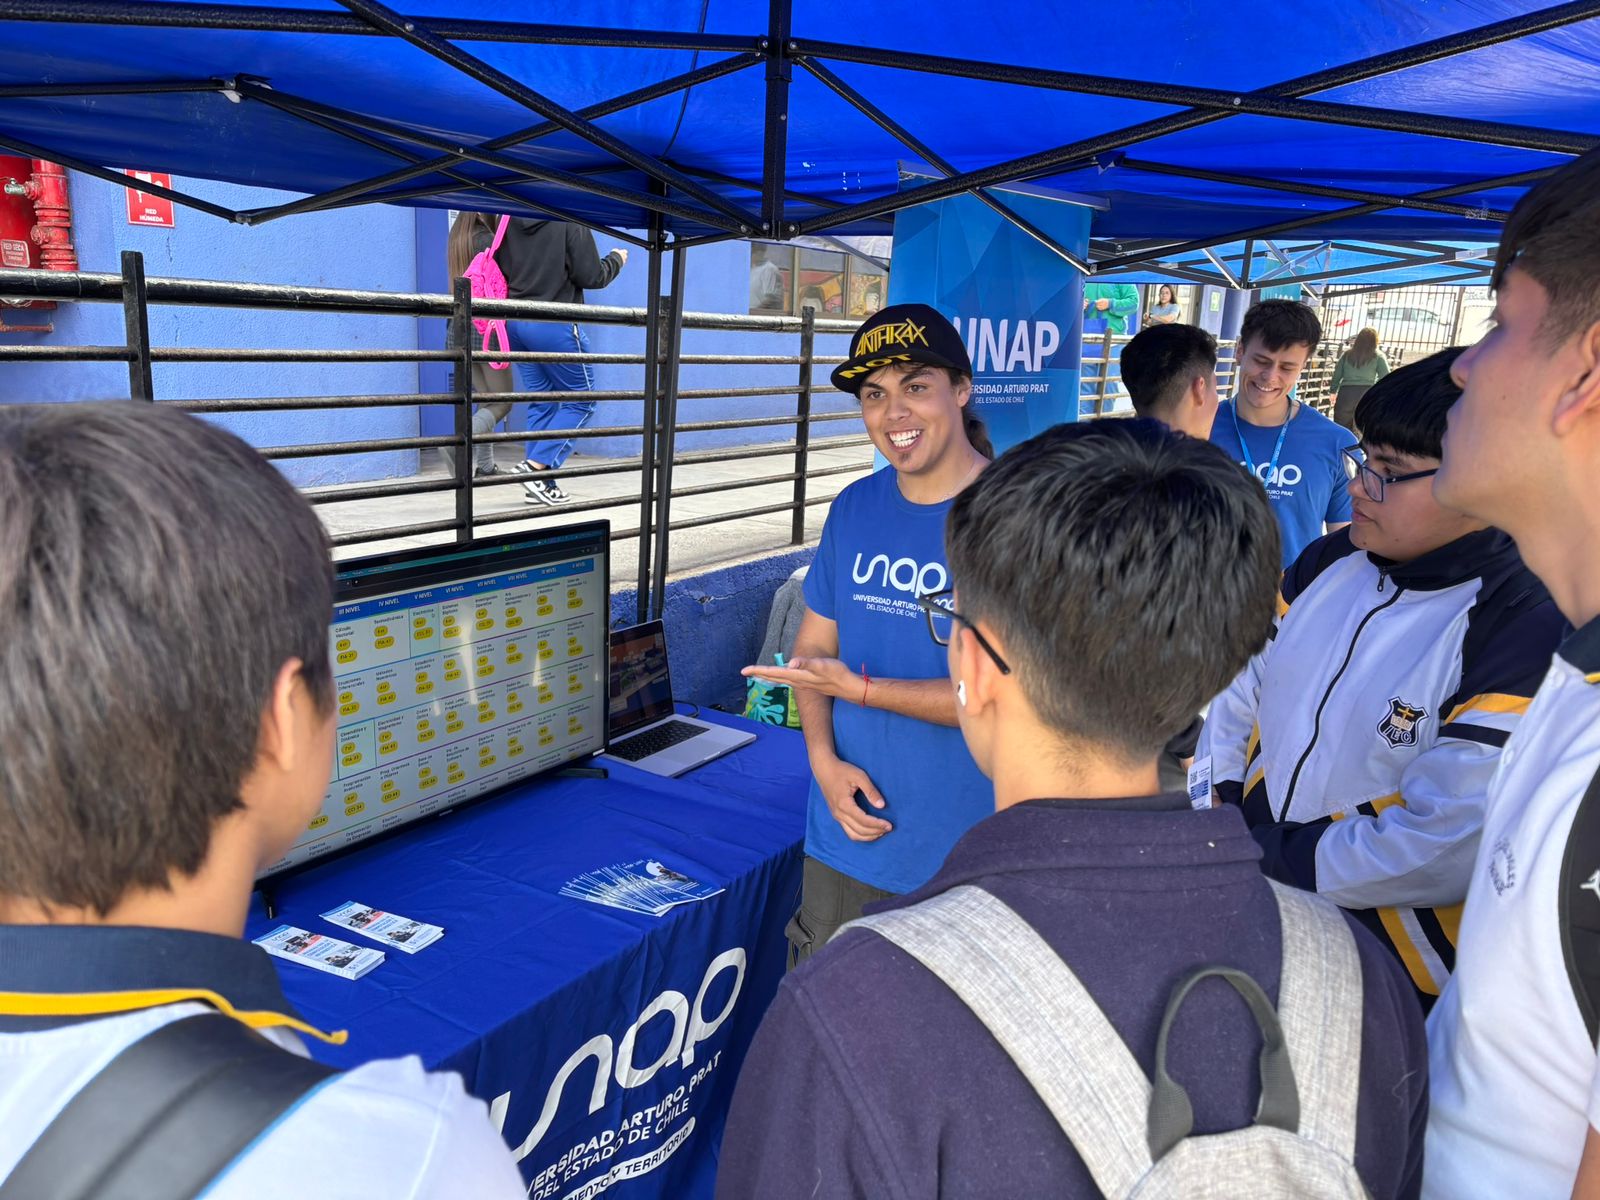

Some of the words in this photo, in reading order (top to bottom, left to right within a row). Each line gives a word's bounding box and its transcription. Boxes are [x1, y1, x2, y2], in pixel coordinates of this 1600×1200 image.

[855, 318, 929, 358] ANTHRAX
[839, 354, 912, 379] NOT
[971, 384, 1003, 394] ERSIDAD
[1003, 384, 1030, 393] ARTURO
[1030, 383, 1050, 393] PRAT
[985, 396, 1005, 404] ESTADO
[852, 552, 947, 599] unap
[418, 591, 432, 599] NIVEL
[451, 585, 464, 593] NIVEL
[345, 605, 360, 614] NIVEL
[384, 597, 399, 606] NIVEL
[853, 594, 891, 606] UNIVERSIDAD
[892, 599, 917, 612] ARTURO
[866, 603, 877, 612] DEL
[877, 605, 896, 614] ESTADO
[905, 610, 918, 619] CHILE
[527, 1130, 615, 1195] ERSIDAD
[620, 1084, 686, 1132] ARTURO
[689, 1050, 722, 1093] PRAT
[534, 1179, 560, 1200] DEL
[563, 1137, 624, 1183] ESTADO
[628, 1125, 650, 1145] DE
[655, 1097, 690, 1135] CHILE
[611, 1167, 621, 1180] Y
[625, 1126, 690, 1176] TERRITORIO
